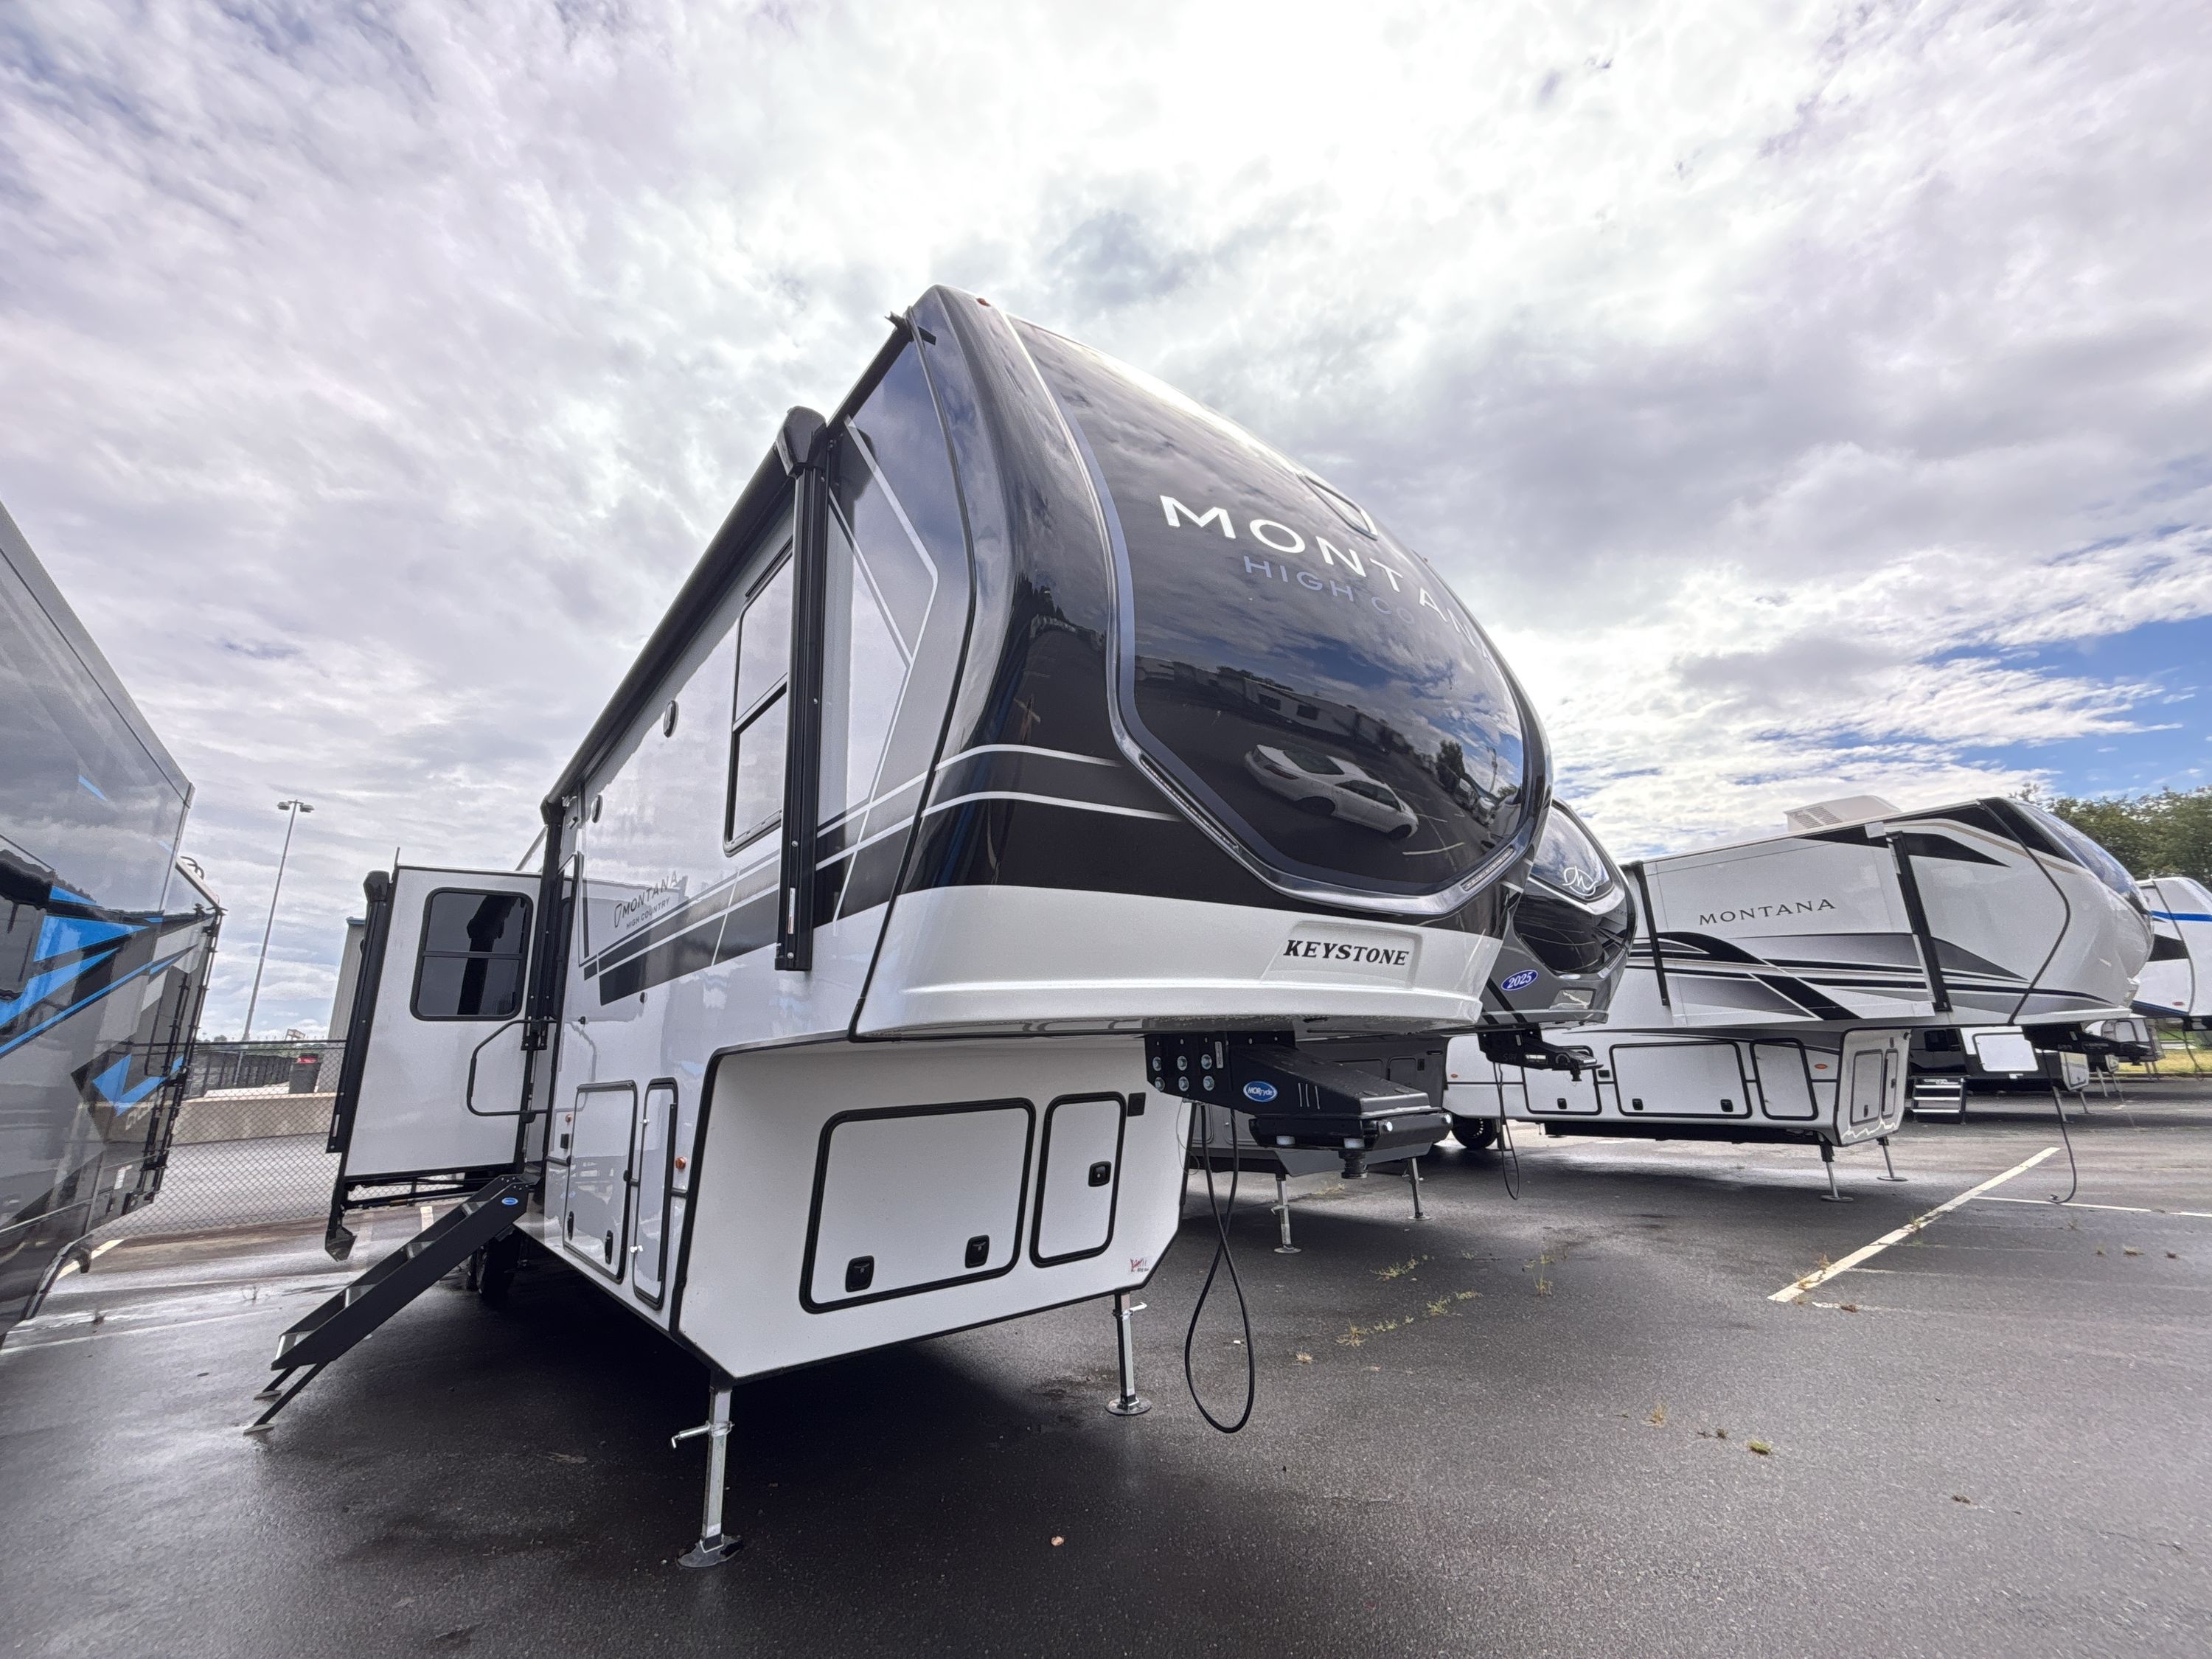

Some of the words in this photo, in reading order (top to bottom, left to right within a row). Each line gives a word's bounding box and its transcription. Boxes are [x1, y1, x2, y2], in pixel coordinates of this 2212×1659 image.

[1243, 555, 1354, 602] HIGH
[622, 870, 678, 919] MONTANA
[626, 916, 640, 930] HIGH
[641, 896, 670, 922] COUNTRY
[1699, 898, 1836, 925] MONTANA
[1283, 939, 1409, 966] KEYSTONE
[1506, 971, 1534, 989] 2025
